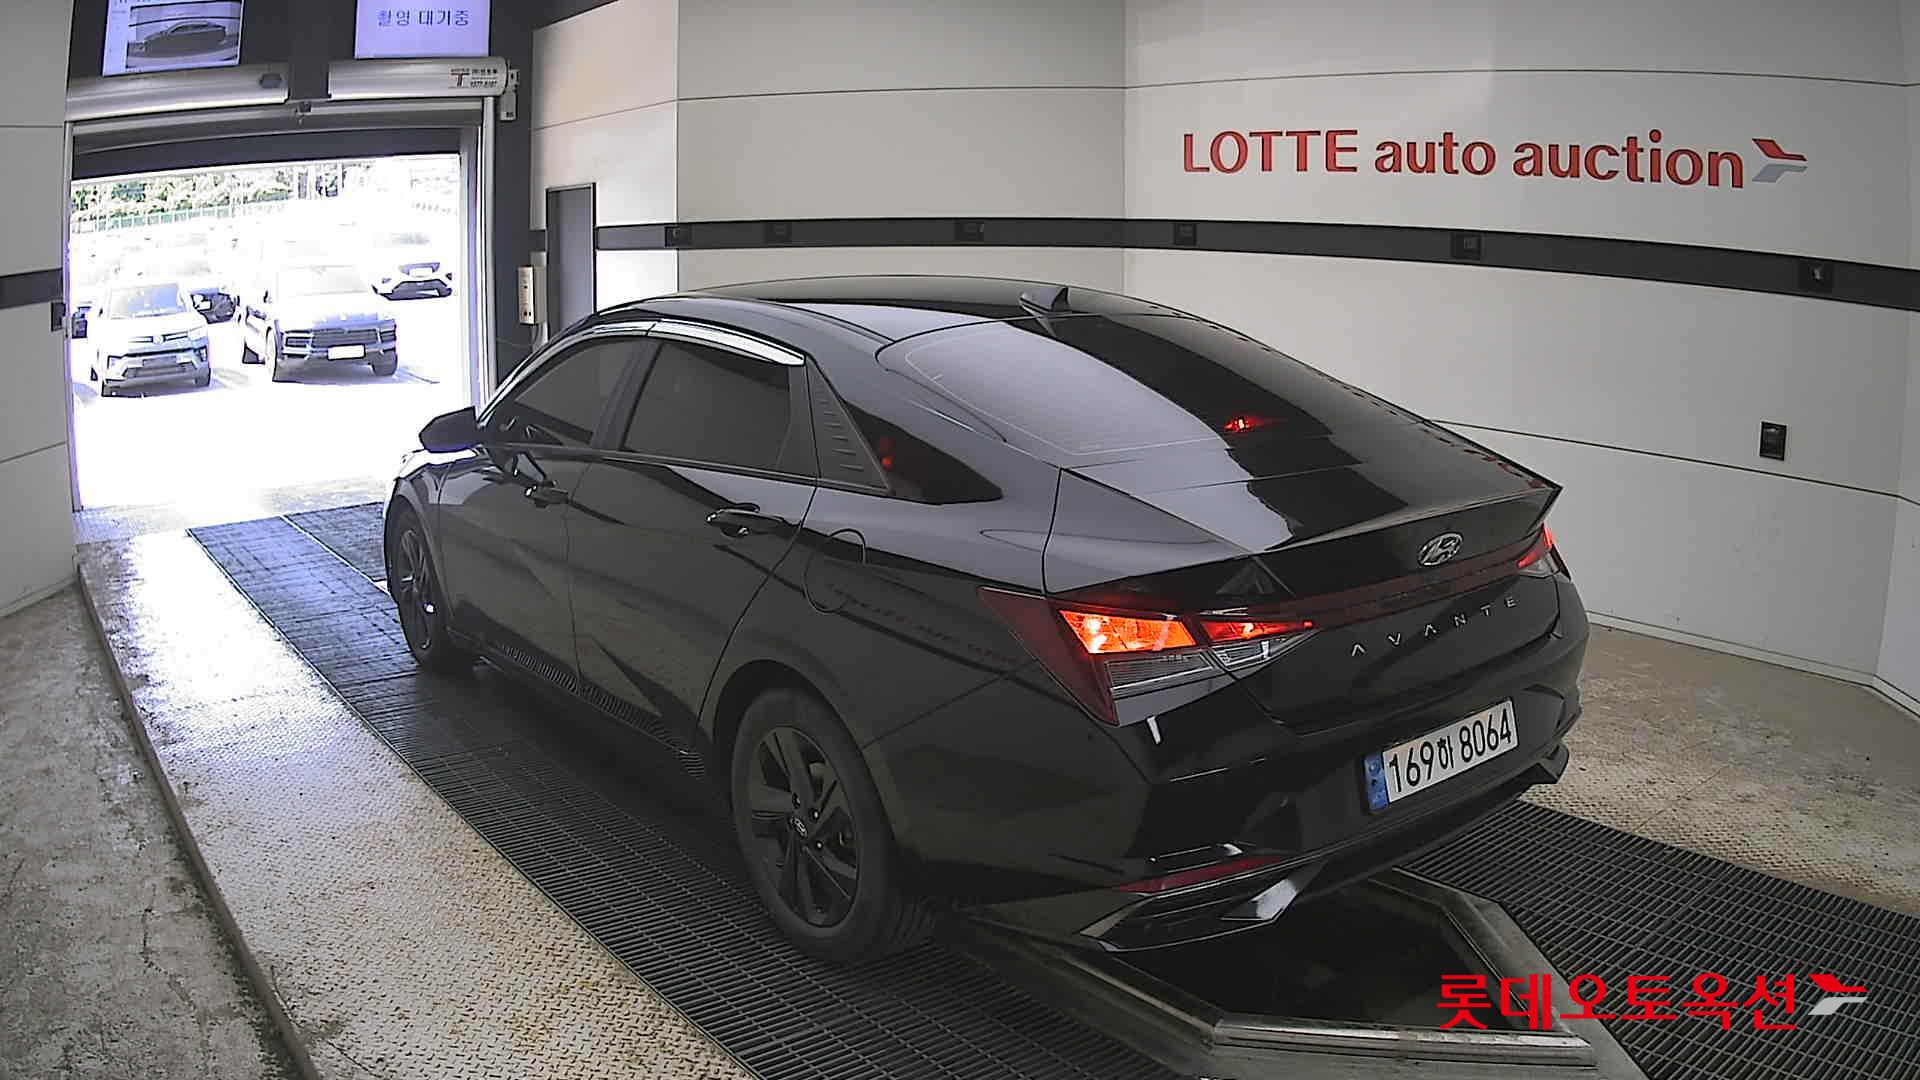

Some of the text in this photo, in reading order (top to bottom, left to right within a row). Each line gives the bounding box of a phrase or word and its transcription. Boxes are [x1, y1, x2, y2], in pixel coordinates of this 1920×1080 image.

[418, 9, 470, 27] 대기중
[1184, 129, 1744, 188] LOTTE auto auction
[1351, 597, 1517, 656] AVANTE
[1459, 708, 1512, 763] 8064
